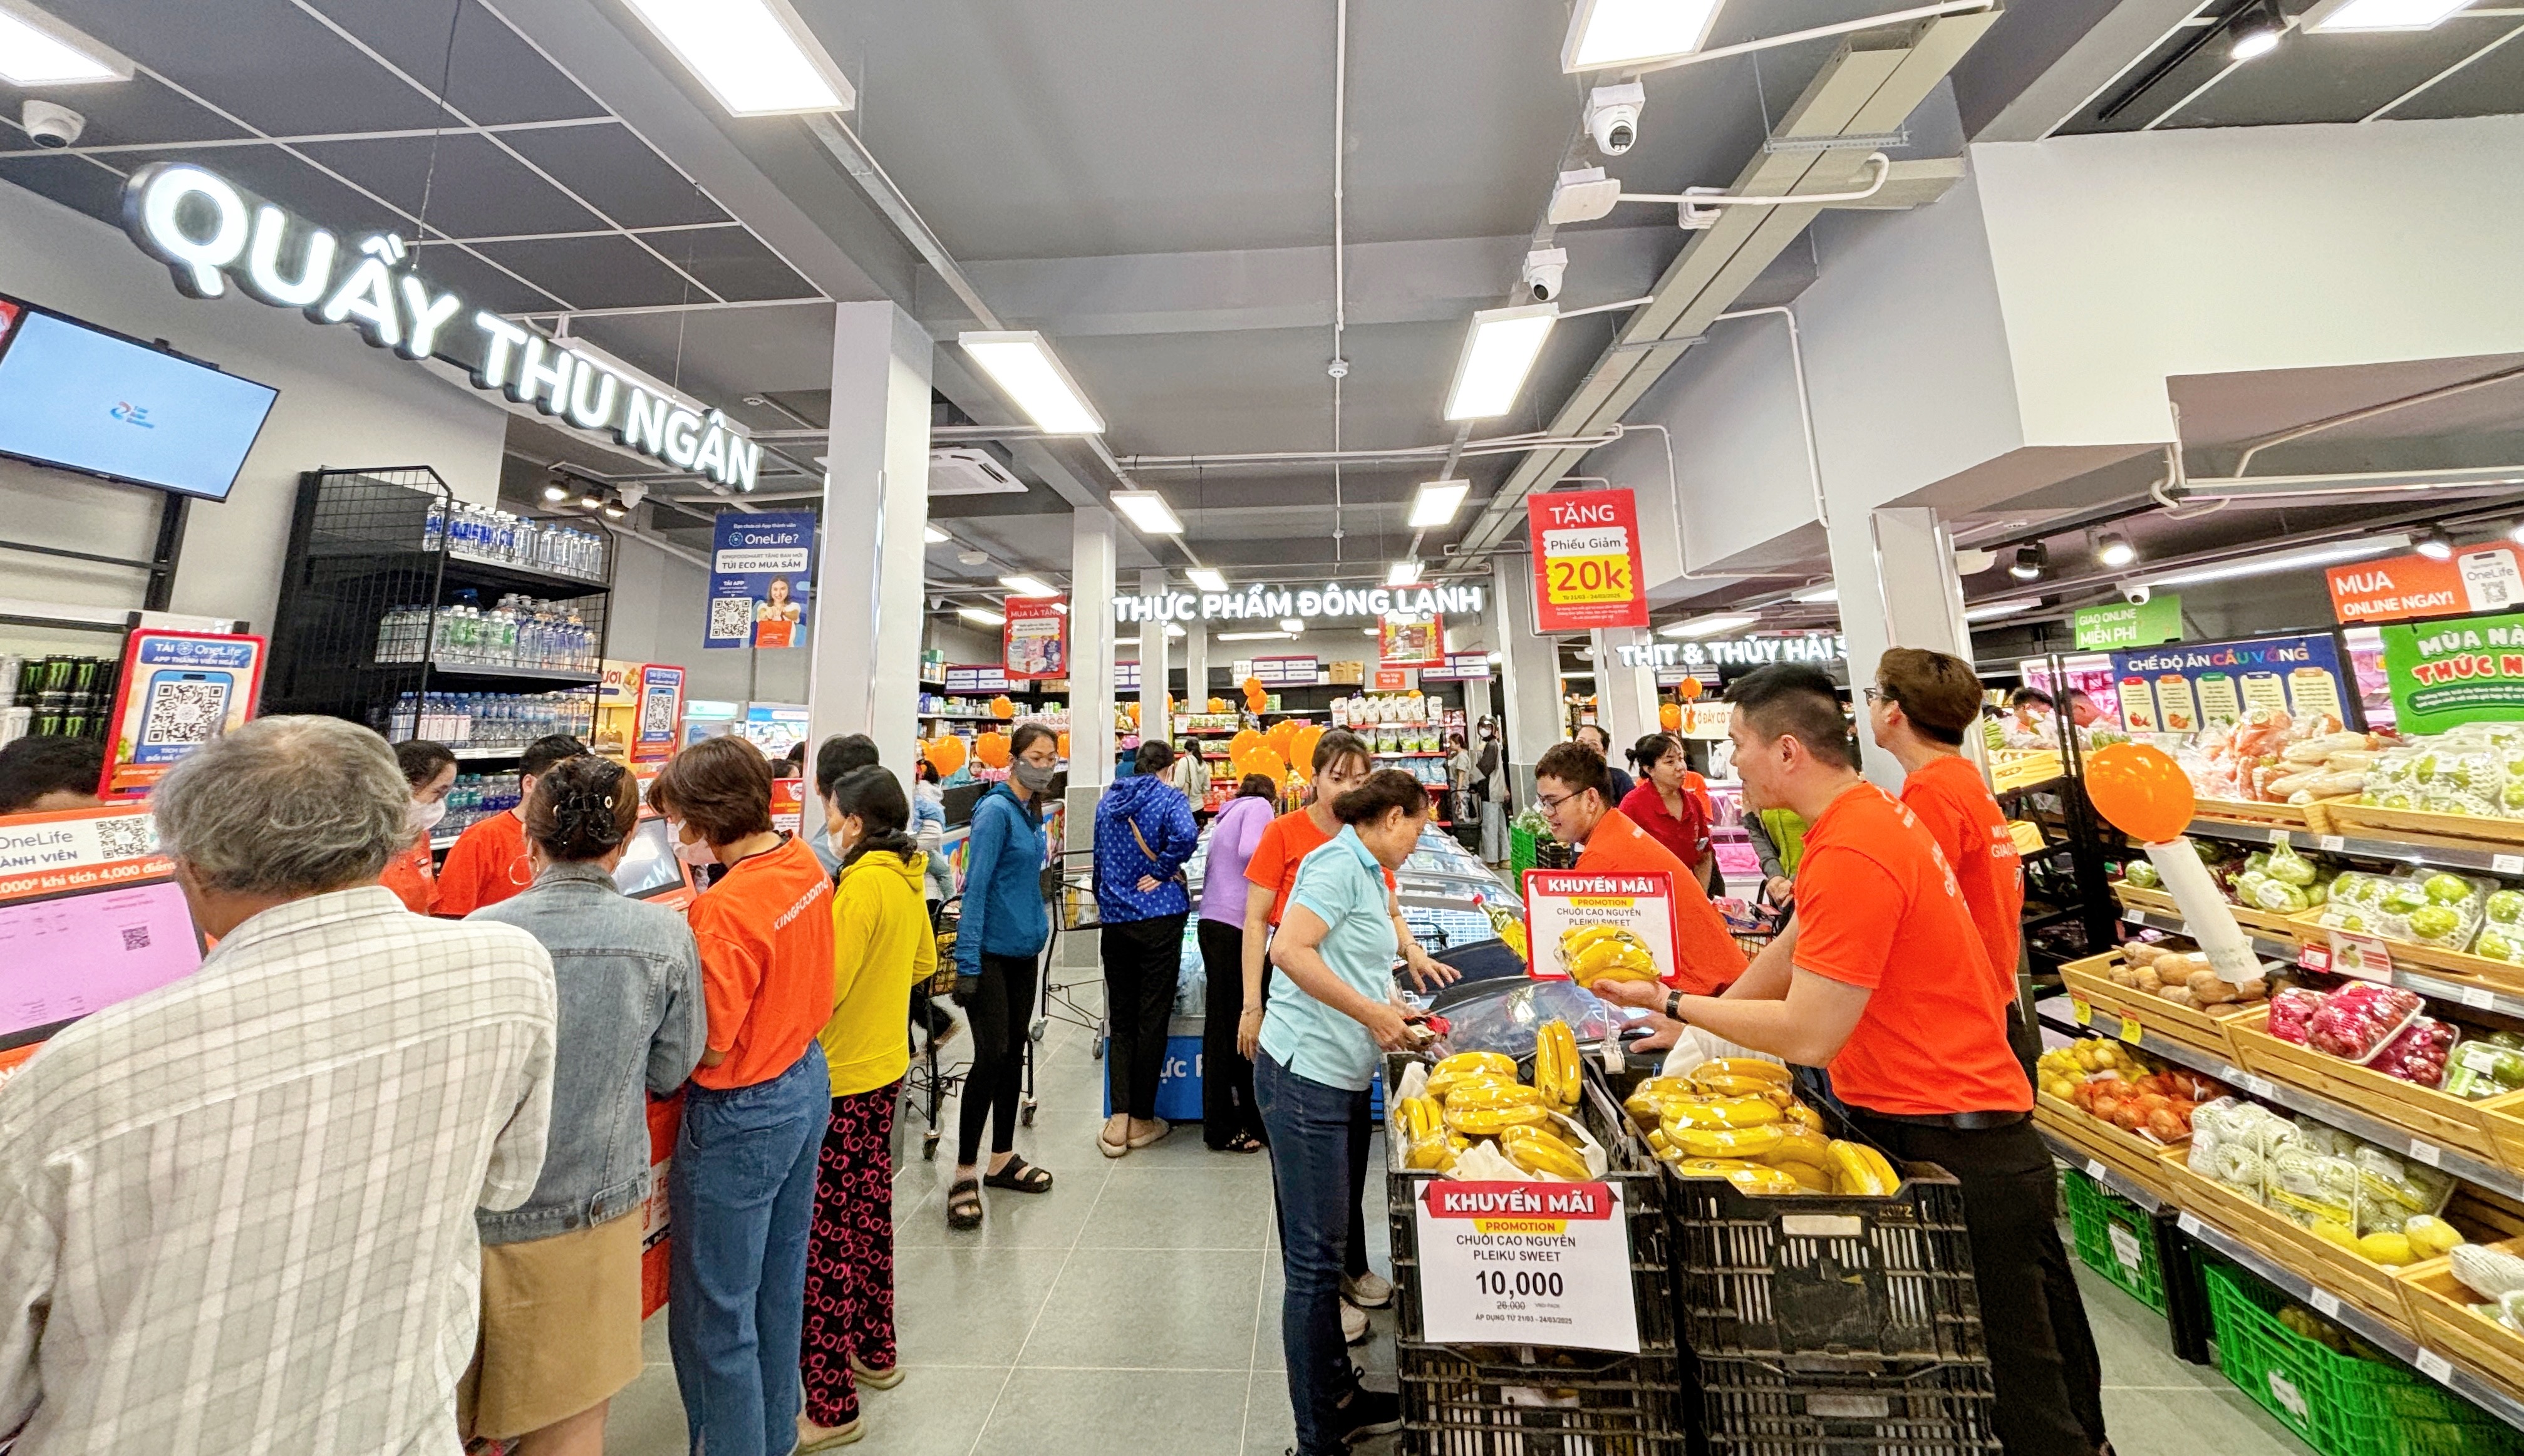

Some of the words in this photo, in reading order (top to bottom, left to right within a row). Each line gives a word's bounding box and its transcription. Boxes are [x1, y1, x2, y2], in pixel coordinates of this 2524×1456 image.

[145, 168, 460, 358] QUẦY
[477, 312, 614, 428] THU
[626, 388, 758, 492] NGÂN
[1549, 502, 1615, 528] TẶNG
[745, 533, 799, 544] OneLife?
[1551, 535, 1585, 550] Phiếu
[1589, 536, 1621, 549] Giảm
[782, 559, 800, 568] SẮM
[1554, 559, 1625, 591] 20k
[2466, 565, 2514, 582] OneLife
[2335, 571, 2395, 596] MUA
[1112, 592, 1196, 626] THỰC
[1203, 584, 1291, 619] PHẨM
[1298, 583, 1390, 616] ĐÔNG
[1397, 586, 1482, 619] LẠNH
[2344, 597, 2400, 616] ONLINE
[2402, 591, 2455, 610] NGAY!
[1030, 609, 1039, 617] LÀ
[2079, 614, 2101, 626] GIAO
[2102, 608, 2136, 622] ONLINE
[2081, 624, 2111, 646] MIỄN
[2114, 621, 2137, 642] PHÍ
[155, 642, 175, 653] TẢI
[195, 644, 242, 656] OneLife
[1616, 643, 1678, 672] THỊT
[1684, 643, 1704, 664] &
[1705, 634, 1779, 663] THỦY
[1785, 633, 1833, 661] HẢI
[2417, 630, 2482, 657] MÙA
[2128, 654, 2159, 671] CHẾ
[2160, 654, 2184, 672] ĐỘ
[2186, 653, 2211, 669] ĂN
[2212, 648, 2249, 666] CẦU
[2413, 653, 2495, 685] THỨC
[601, 669, 622, 684] ƯƠI
[41, 849, 78, 862] VIÊN
[41, 874, 66, 888] khi
[68, 871, 97, 884] tích
[100, 865, 139, 880] 4,000
[1548, 875, 1617, 893] KHUYẾN
[1621, 877, 1654, 893] MÃI
[1606, 908, 1641, 917] NGUYÊN
[1444, 1187, 1541, 1213] KHUYẾN
[1549, 1190, 1595, 1214] MÃI
[1486, 1222, 1555, 1231] PROMOTION
[1456, 1232, 1493, 1246] CHUỐI
[1497, 1236, 1522, 1246] CAO
[1526, 1234, 1576, 1247] NGUYÊN
[1473, 1251, 1515, 1261] PLEIKU
[1519, 1251, 1561, 1262] SWEET
[1476, 1270, 1563, 1300] 10,000
[1486, 1314, 1504, 1322] DỤNG
